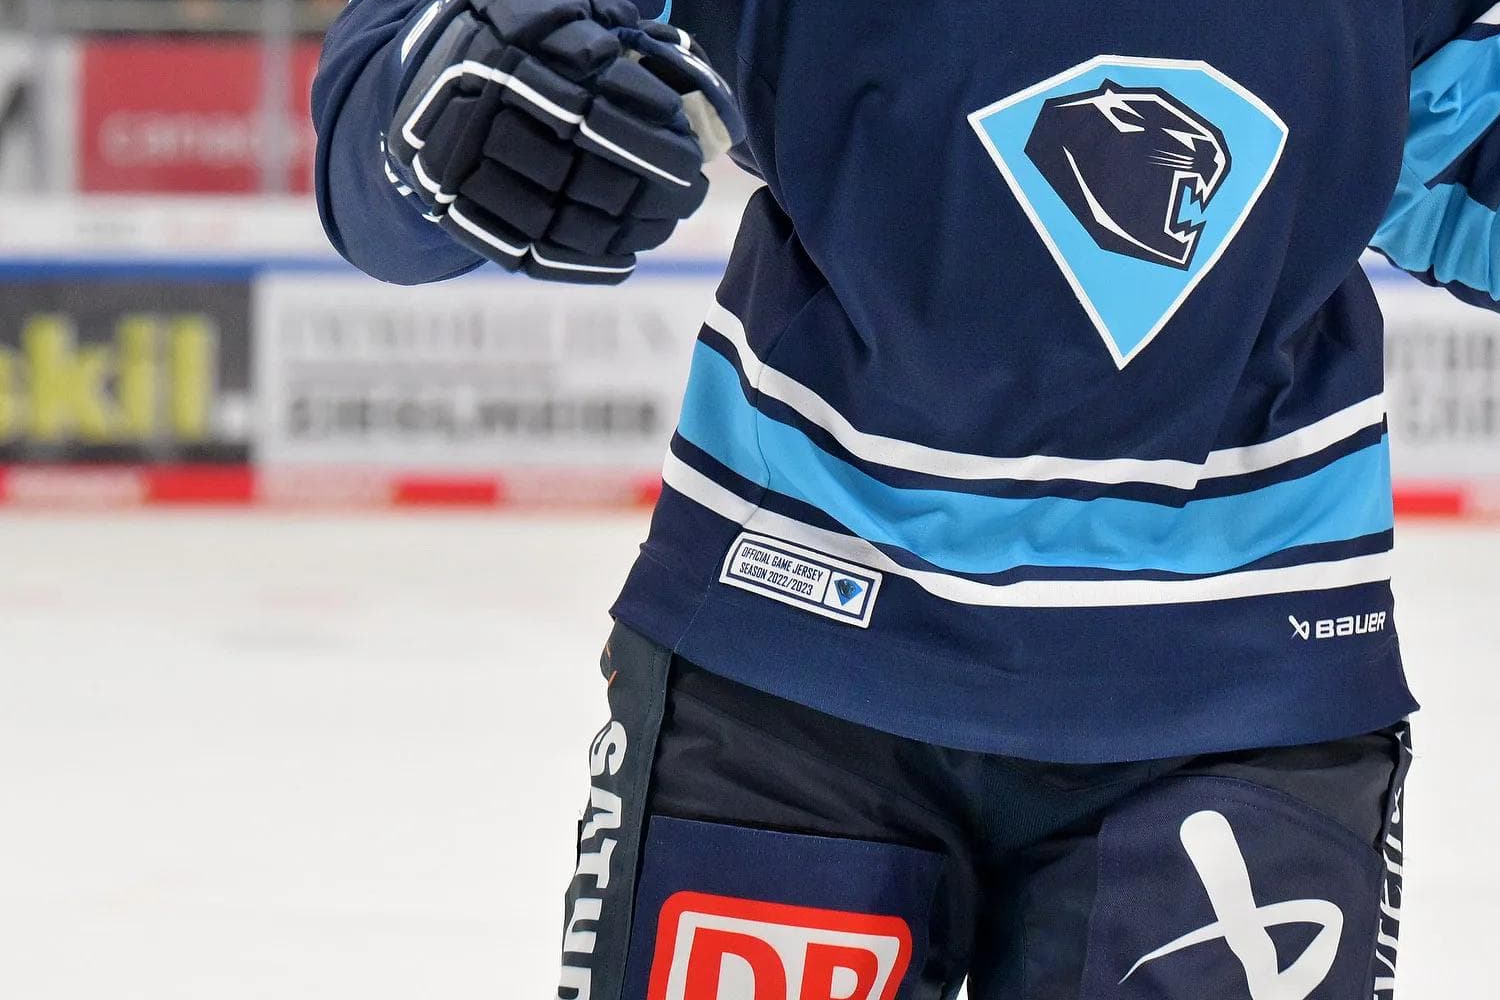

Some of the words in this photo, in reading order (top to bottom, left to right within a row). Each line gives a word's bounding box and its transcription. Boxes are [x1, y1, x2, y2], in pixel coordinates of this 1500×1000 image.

[740, 561, 768, 580] SEASON
[767, 570, 814, 596] 2022/2023
[741, 546, 771, 565] OFFICIAL
[771, 555, 793, 573] GAME
[792, 563, 824, 582] JERSEY
[682, 926, 879, 1000] DB
